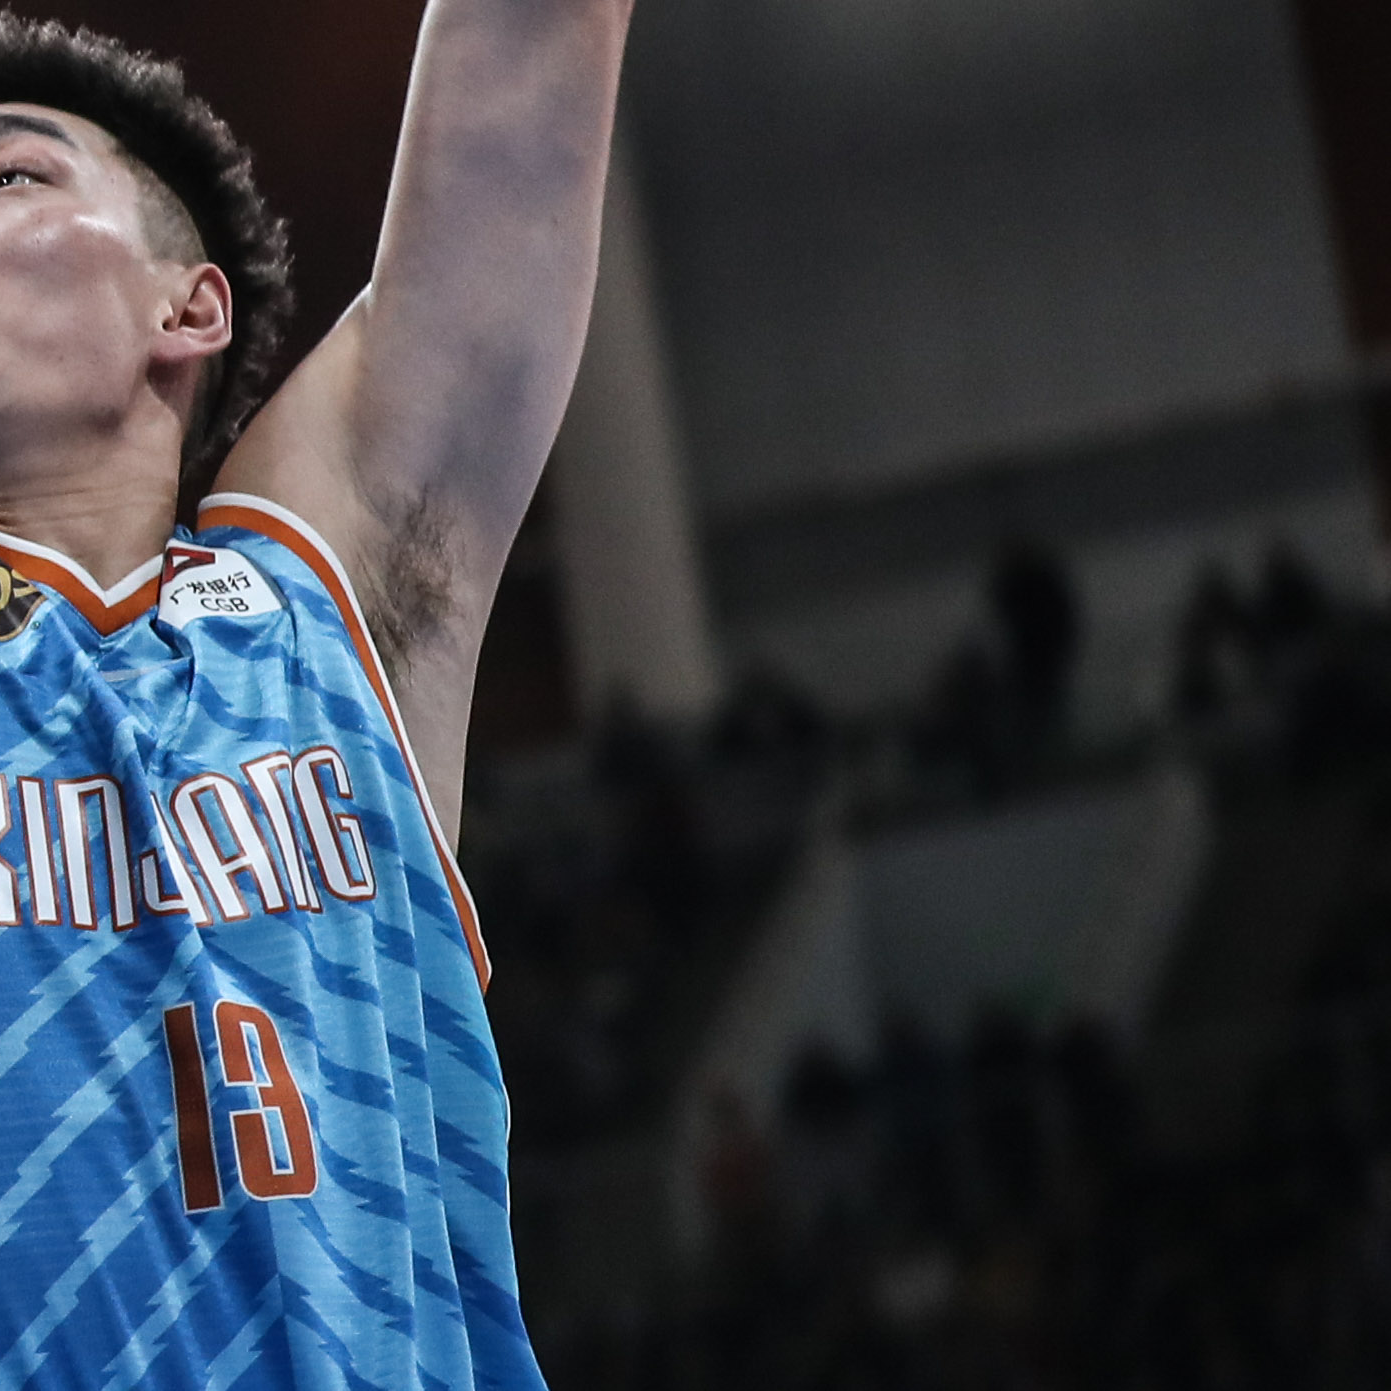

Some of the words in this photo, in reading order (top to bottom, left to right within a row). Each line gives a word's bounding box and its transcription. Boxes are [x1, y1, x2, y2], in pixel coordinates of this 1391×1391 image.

[169, 571, 252, 605] 广发银行
[200, 597, 250, 613] CGB
[161, 999, 319, 1214] 13
